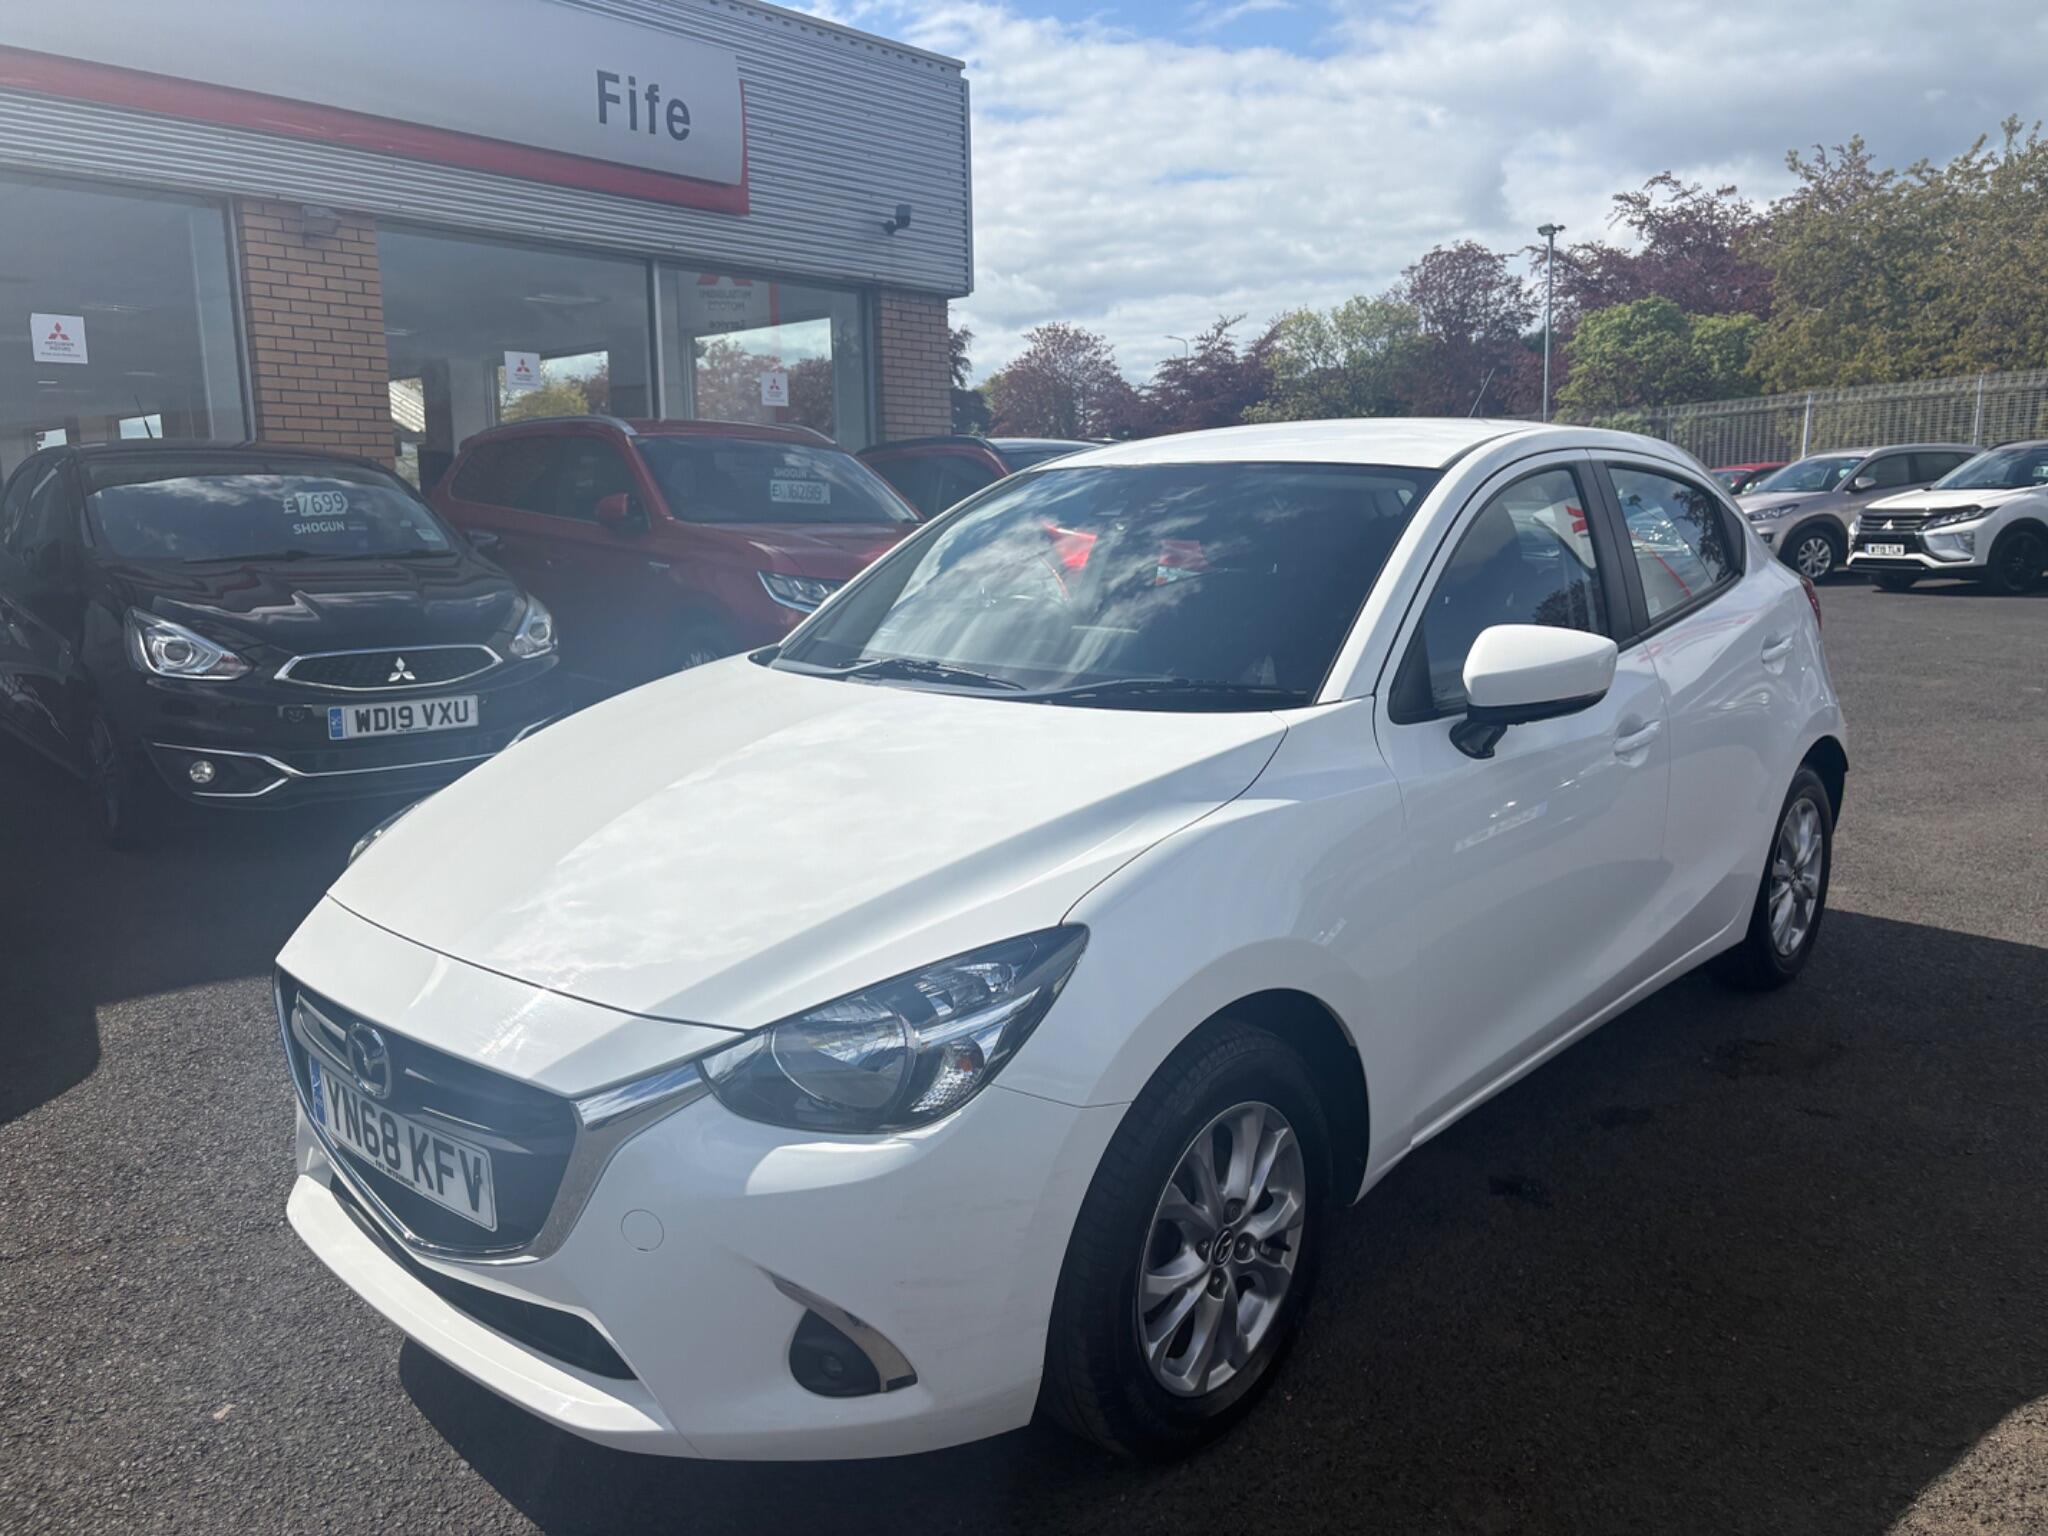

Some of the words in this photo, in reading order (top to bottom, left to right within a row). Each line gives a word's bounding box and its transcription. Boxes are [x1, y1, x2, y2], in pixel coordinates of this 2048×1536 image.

[597, 69, 690, 141] Fife
[293, 520, 345, 535] SHOGUN
[355, 706, 414, 733] WD19
[422, 700, 469, 726] VXU
[324, 1073, 402, 1170] YN68
[408, 1125, 483, 1213] KFV
